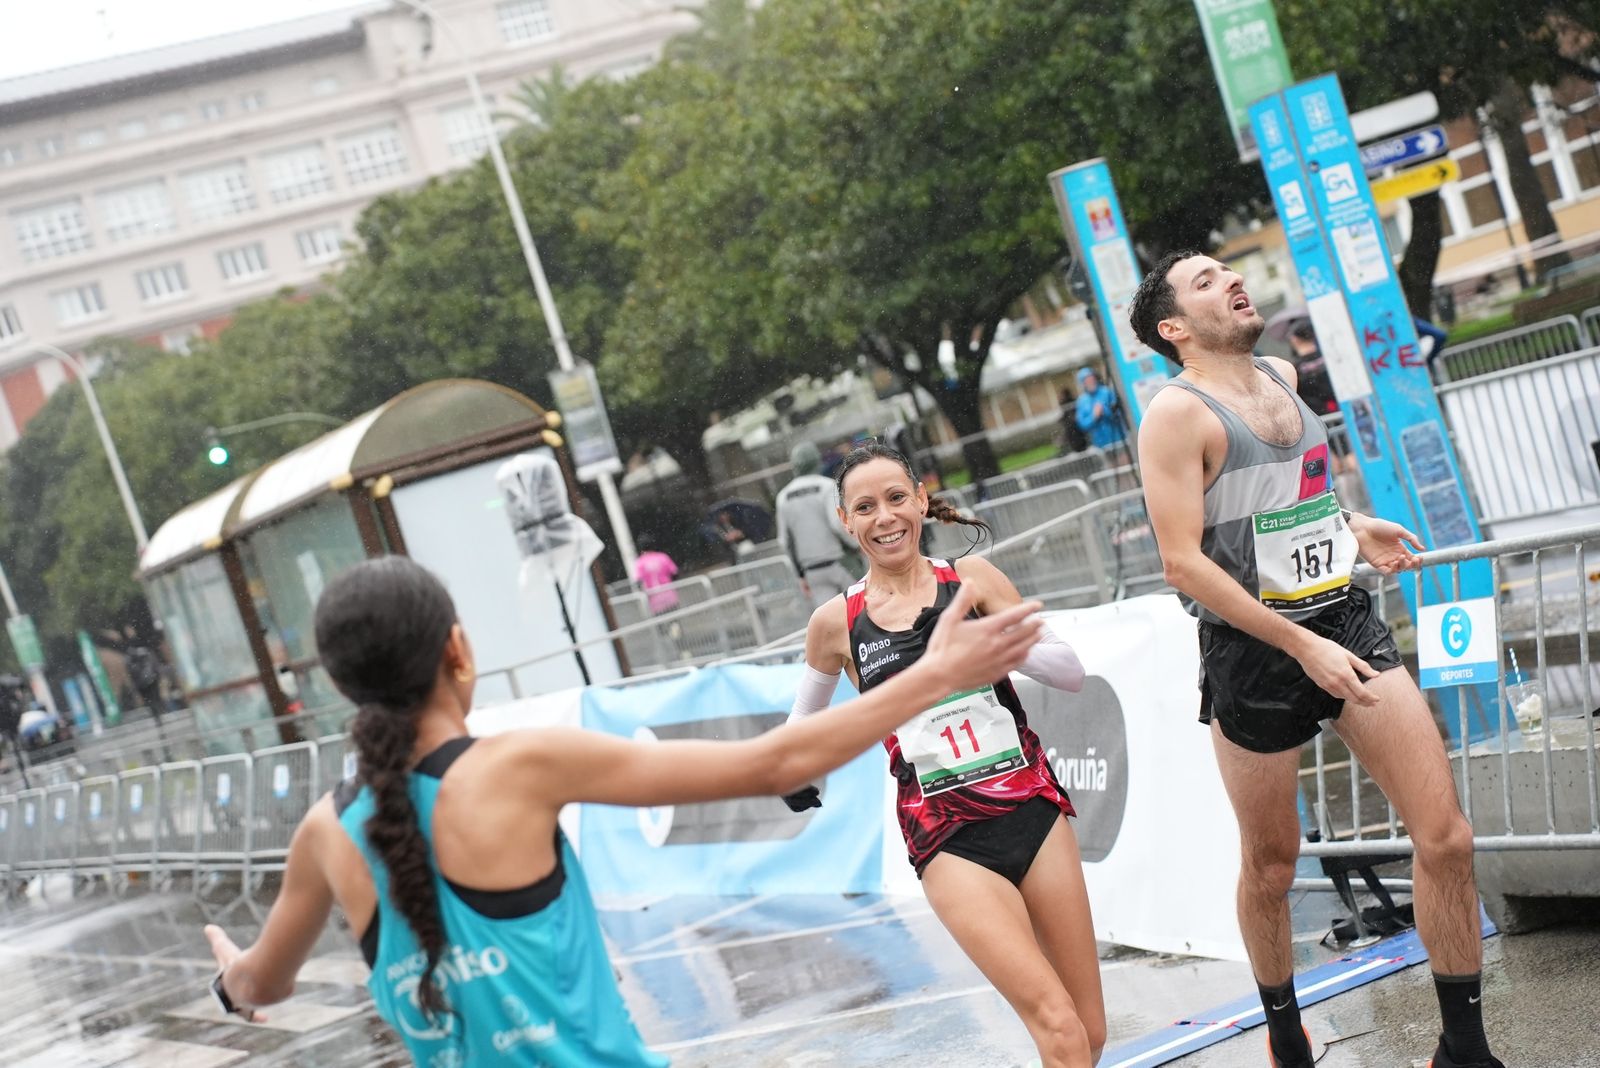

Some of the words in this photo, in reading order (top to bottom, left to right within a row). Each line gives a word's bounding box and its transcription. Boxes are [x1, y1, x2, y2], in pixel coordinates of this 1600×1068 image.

[1291, 538, 1334, 583] 157
[858, 638, 891, 662] Bilbao
[1440, 668, 1474, 681] DEPORTES
[940, 718, 981, 760] 11
